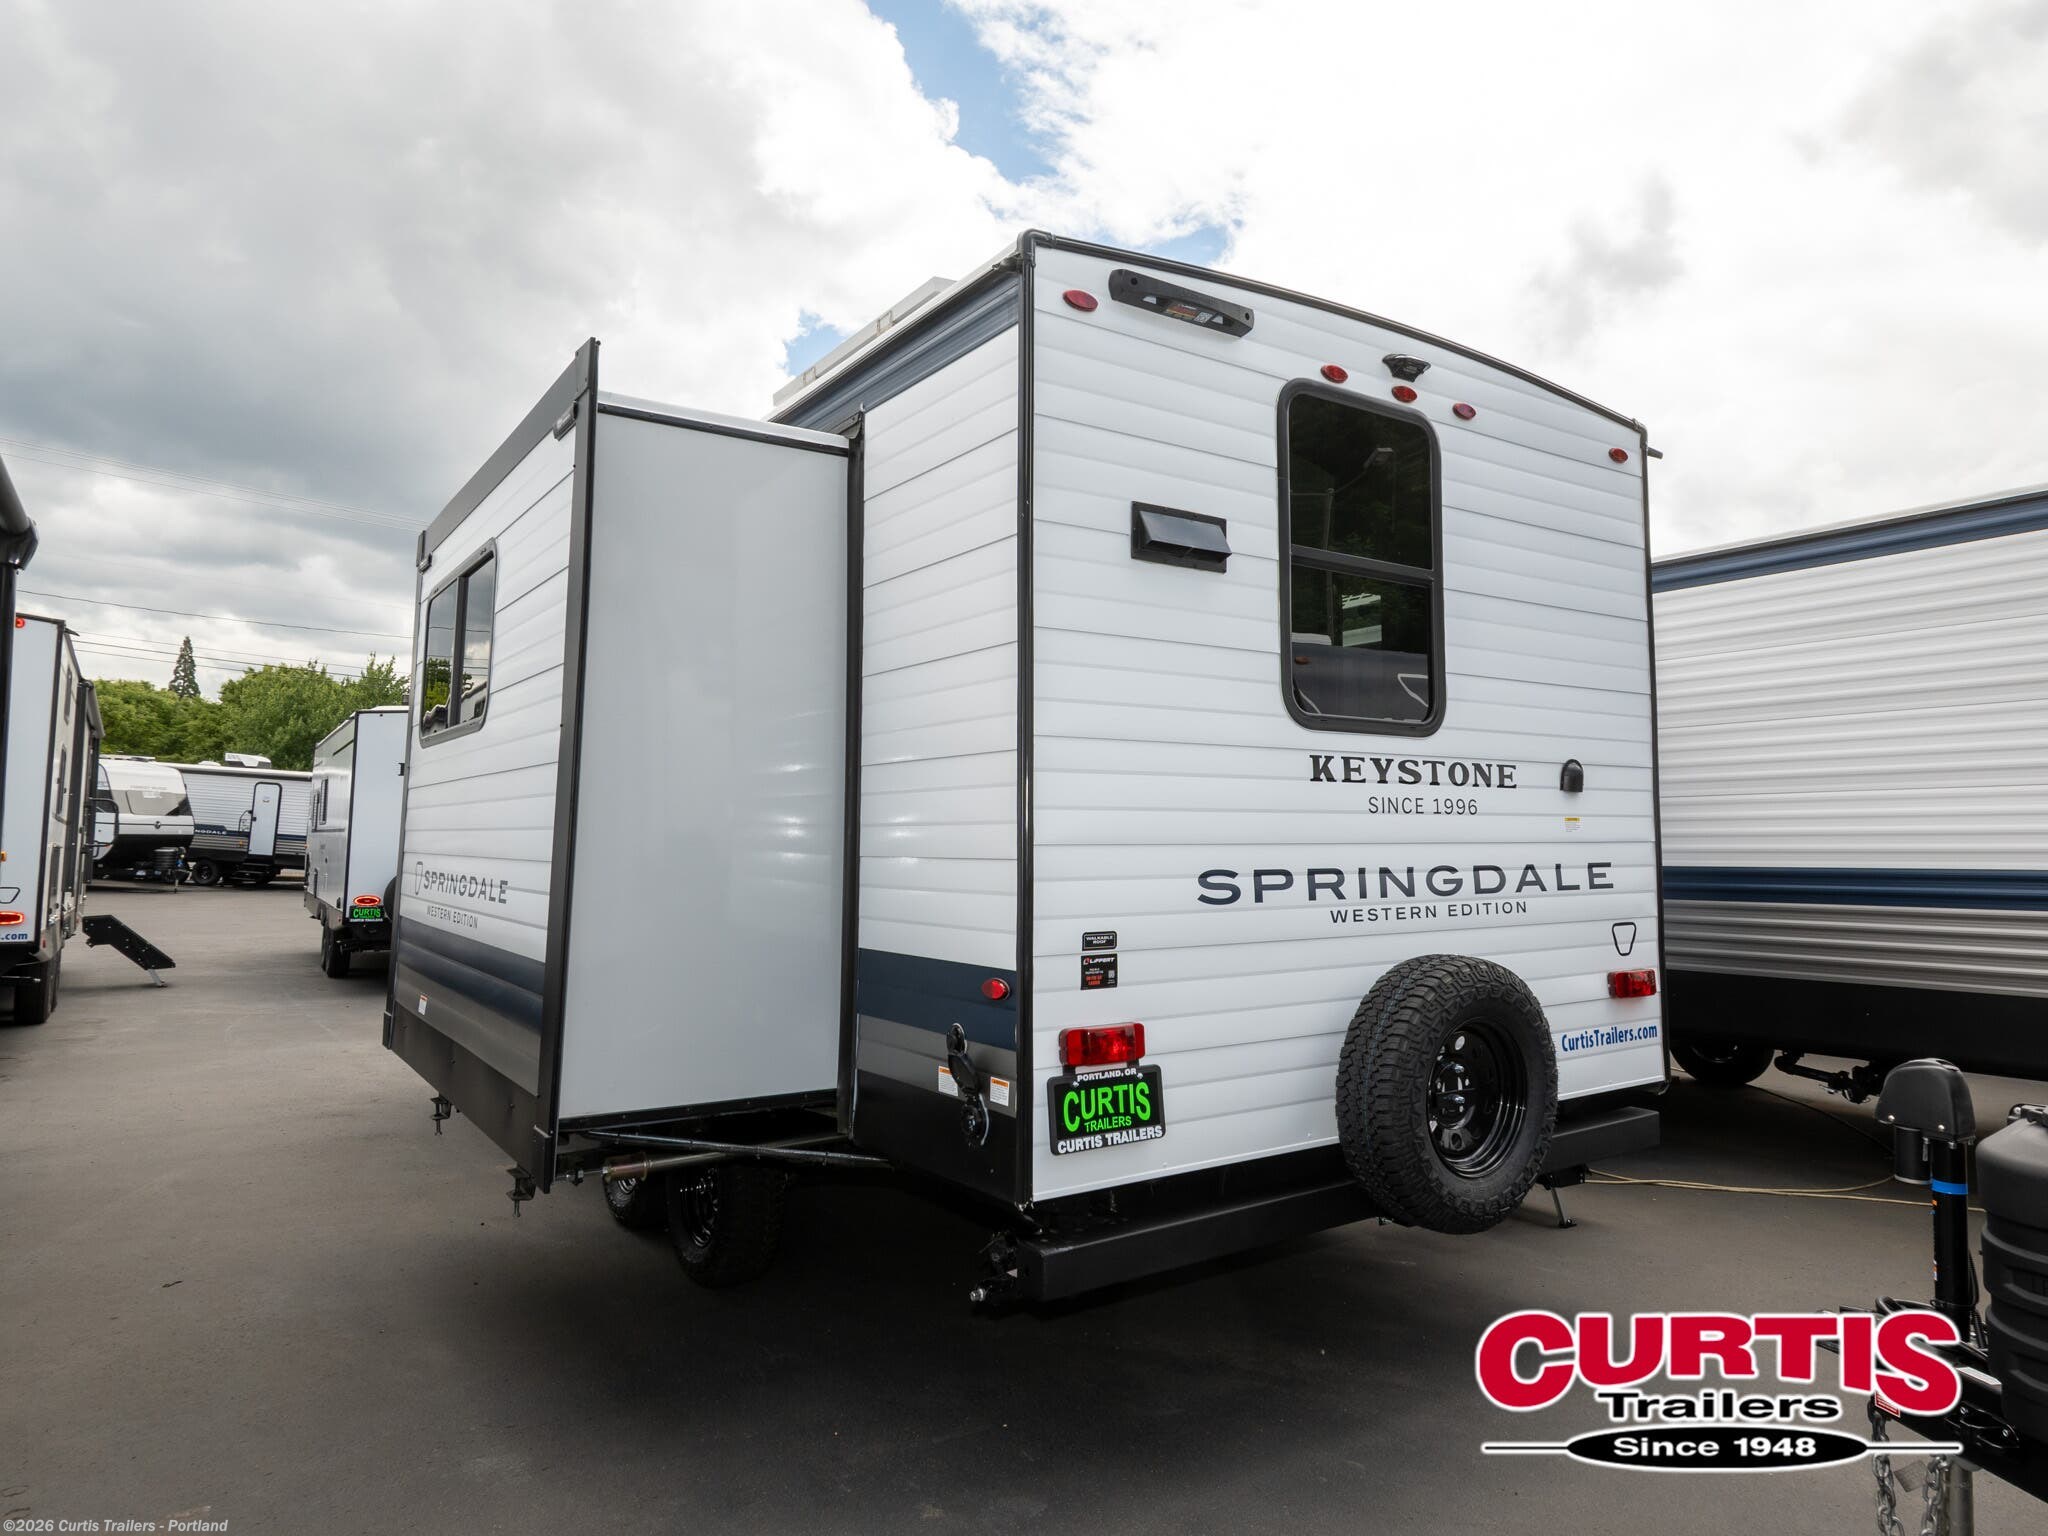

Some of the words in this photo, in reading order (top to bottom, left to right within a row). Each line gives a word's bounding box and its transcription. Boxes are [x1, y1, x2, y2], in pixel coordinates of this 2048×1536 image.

[1309, 754, 1517, 789] KEYSTONE
[1368, 796, 1425, 815] SINCE
[1433, 798, 1478, 816] 1996
[423, 870, 509, 904] SPRINGDALE
[1197, 862, 1614, 905] SPRINGDALE
[353, 908, 381, 918] CURTIS
[426, 905, 451, 924] WESTERN
[453, 911, 479, 929] EDITION
[1330, 905, 1437, 924] WESTERN
[1448, 901, 1527, 917] EDITION
[1561, 1026, 1658, 1053] CurtisTrailers.com
[1124, 1067, 1137, 1076] OR
[1063, 1081, 1151, 1132] CURTIS
[1084, 1115, 1132, 1132] TRAILERS
[1057, 1135, 1103, 1154] CURTIS
[1106, 1126, 1163, 1146] TRAILERS
